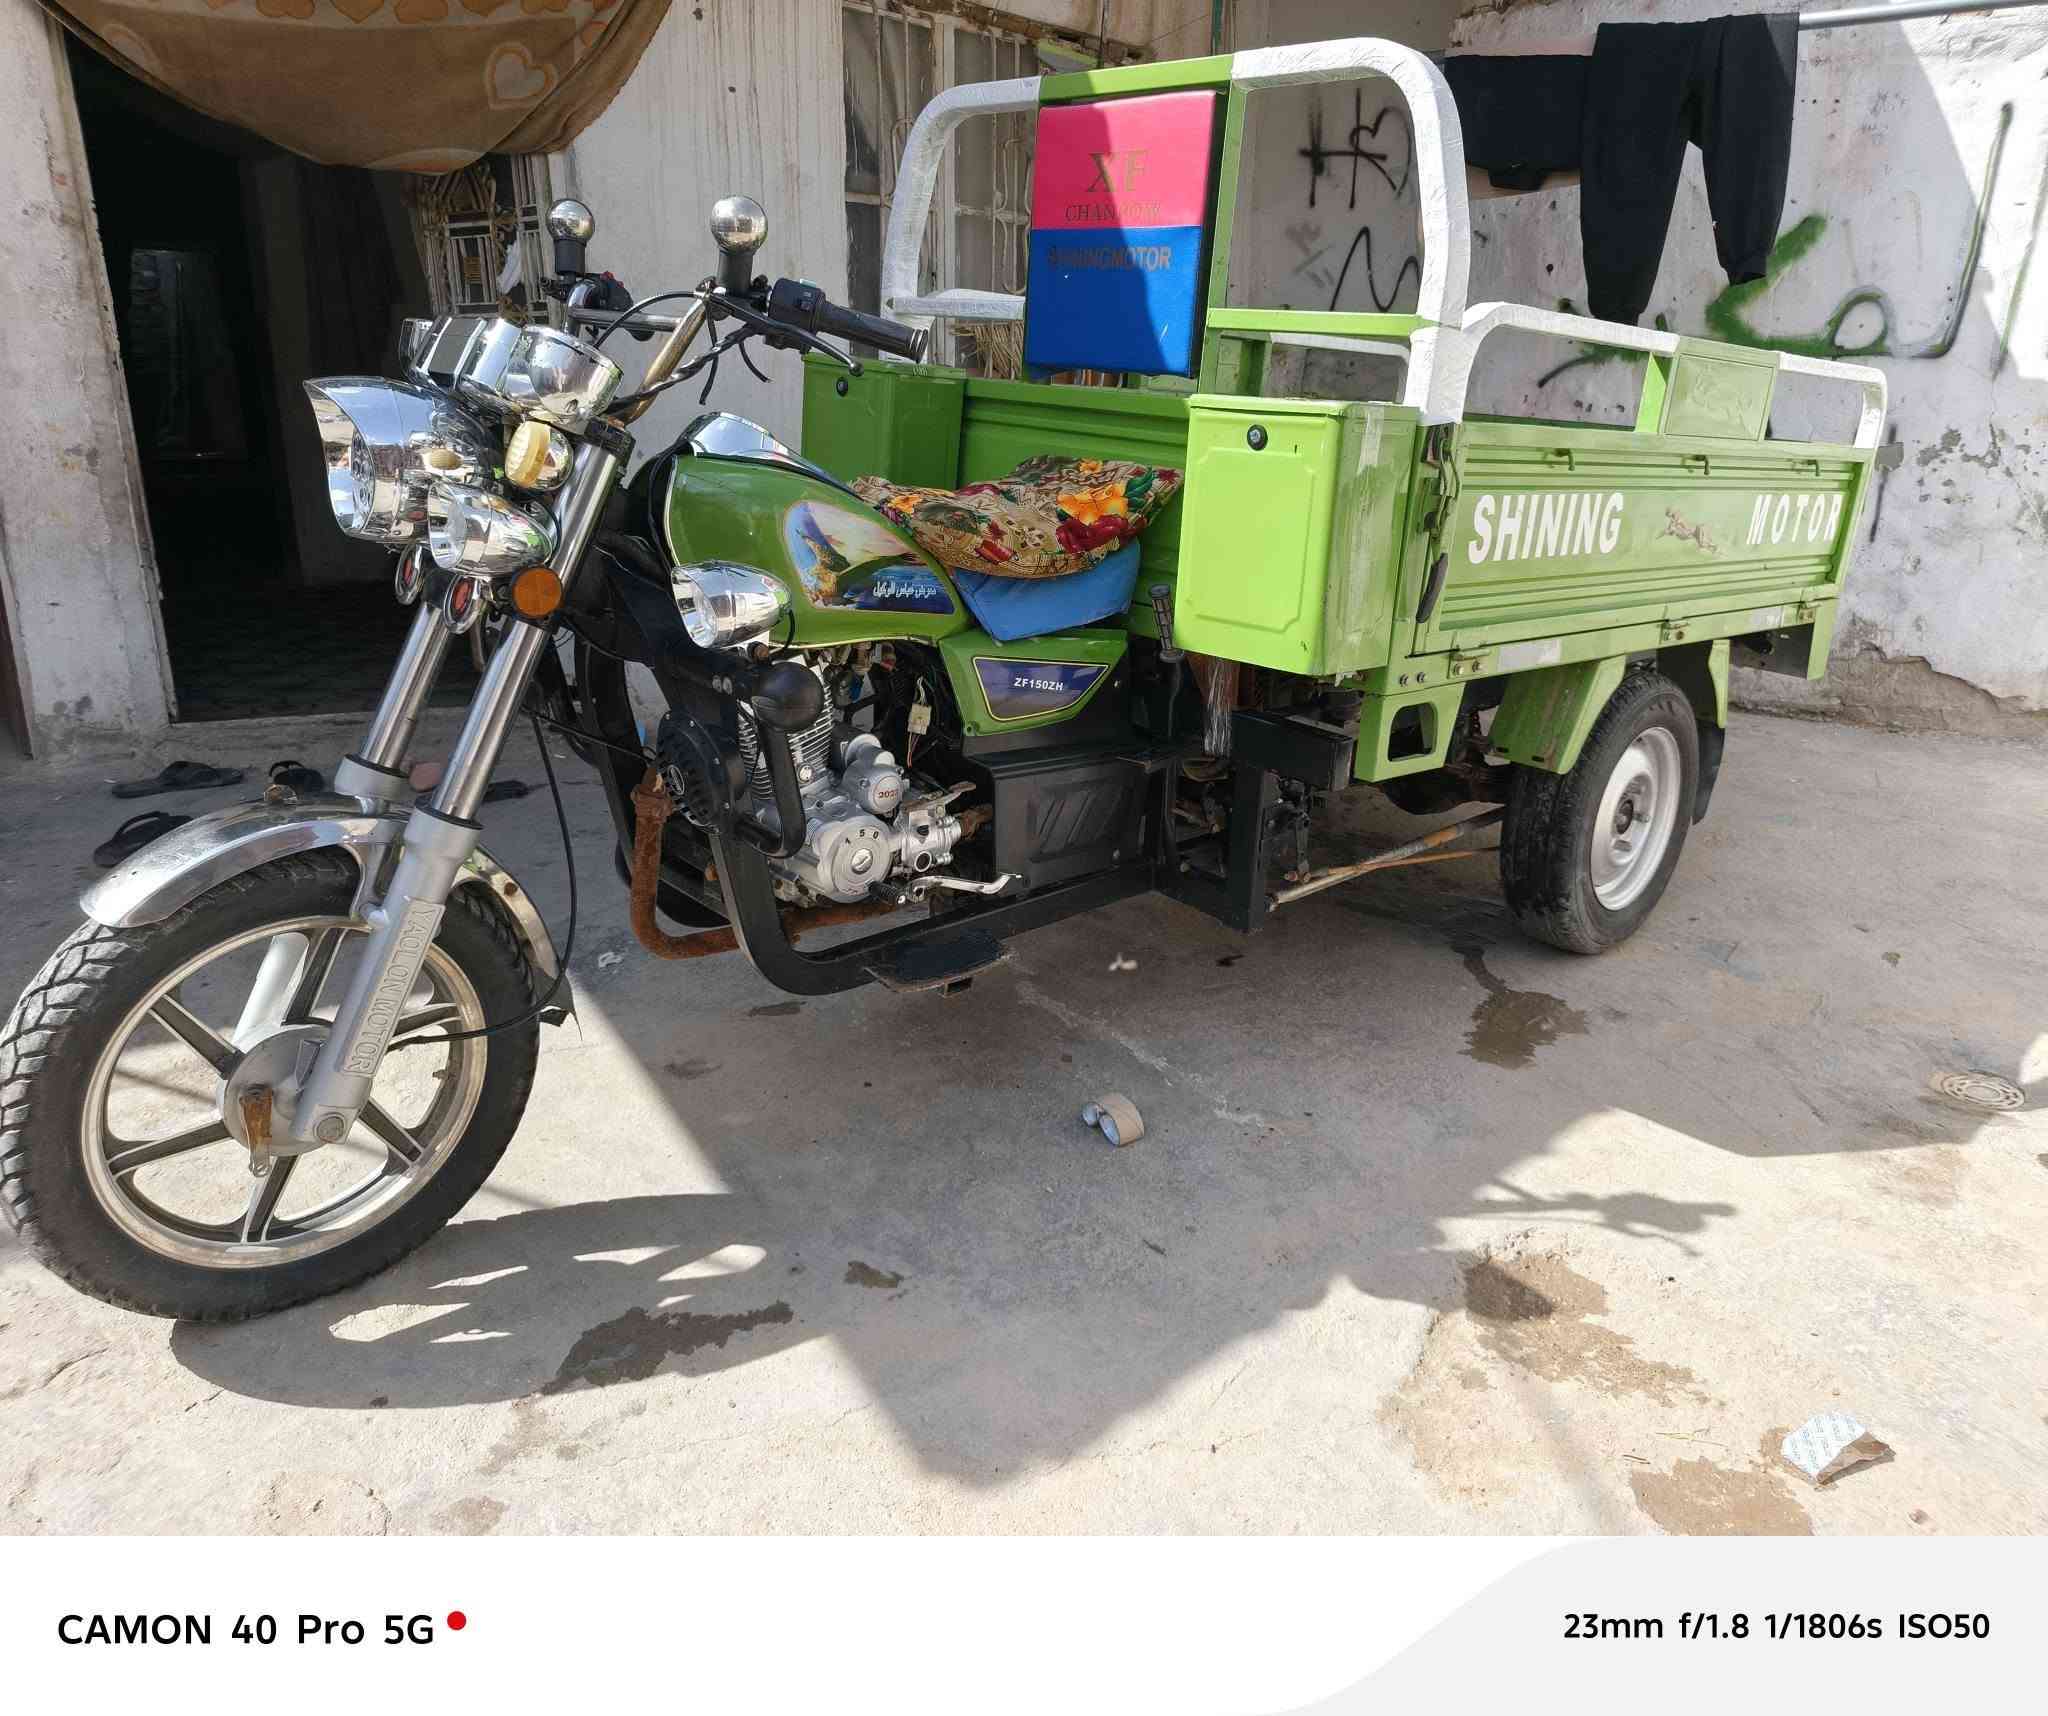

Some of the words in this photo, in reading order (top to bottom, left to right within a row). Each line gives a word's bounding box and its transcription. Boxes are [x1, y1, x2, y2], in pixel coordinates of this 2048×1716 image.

[1086, 151, 1149, 192] XF
[1048, 246, 1172, 271] SININGMOTOR
[1468, 492, 1624, 565] SHINING
[1746, 494, 1843, 545] MOTOR
[1014, 677, 1064, 691] ZF150ZH
[347, 997, 401, 1074] MOTOR
